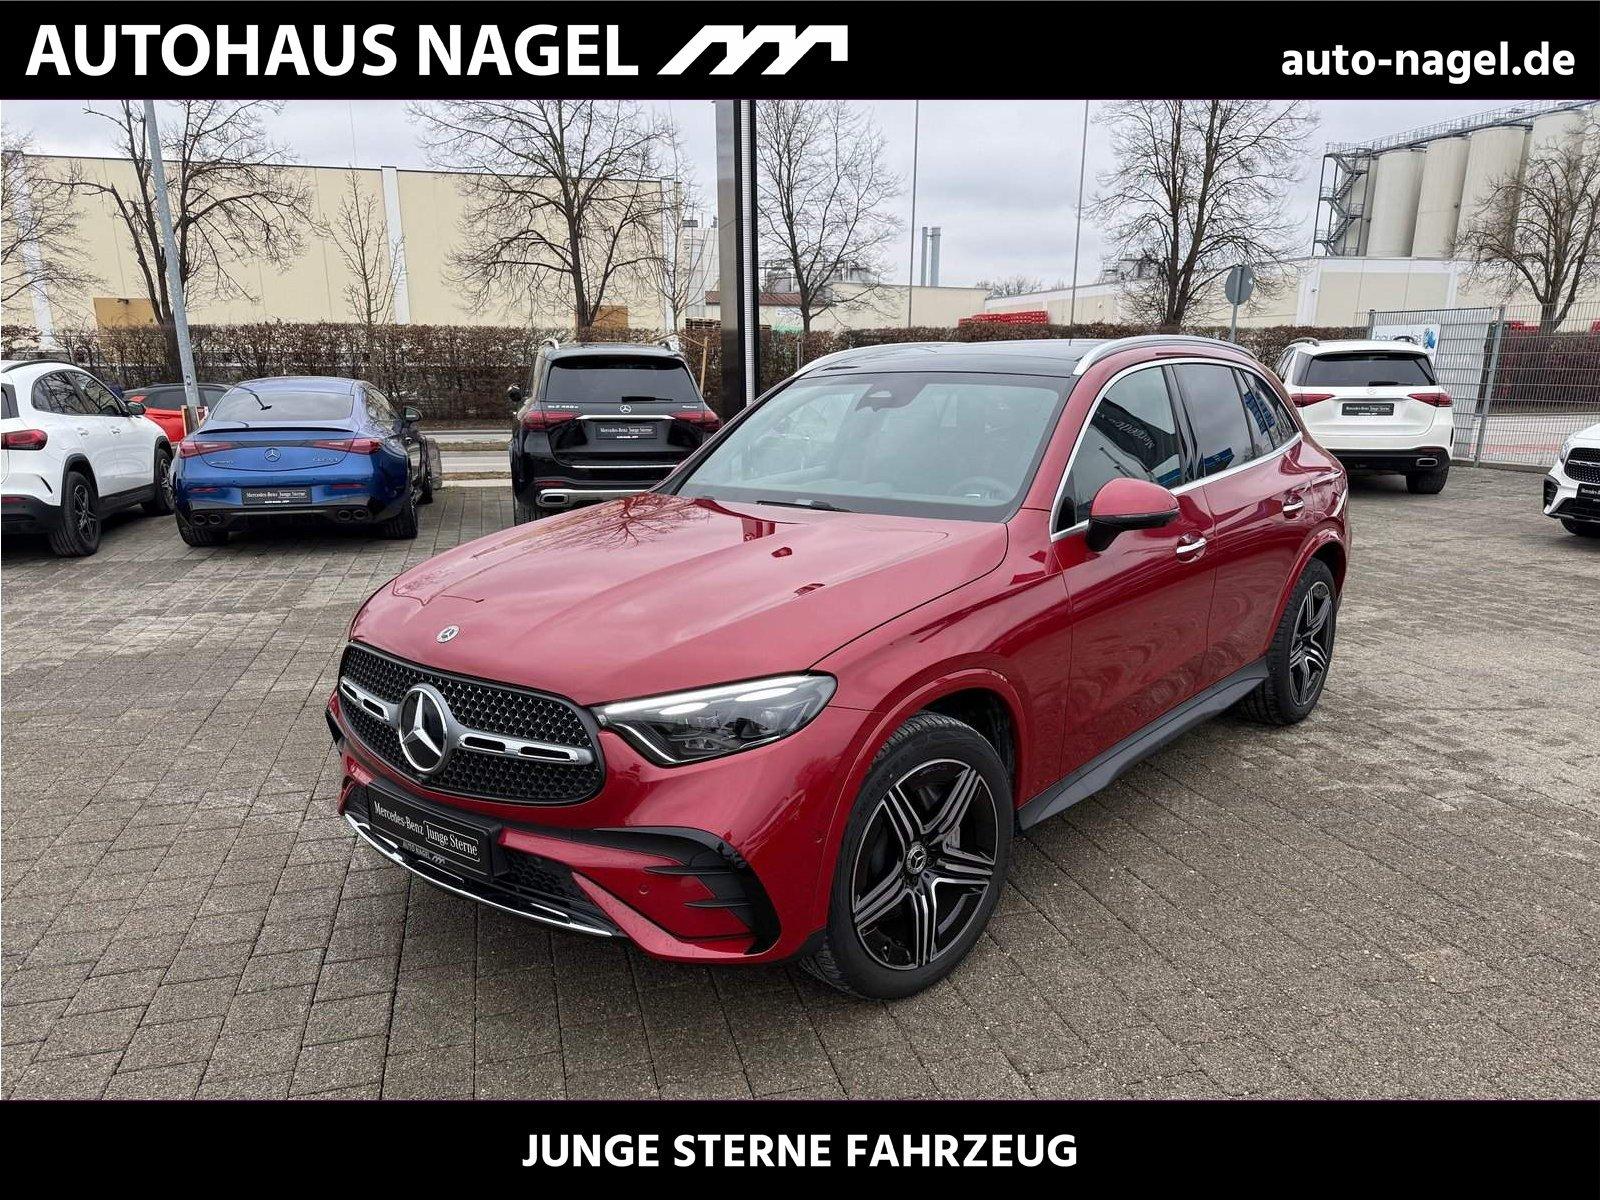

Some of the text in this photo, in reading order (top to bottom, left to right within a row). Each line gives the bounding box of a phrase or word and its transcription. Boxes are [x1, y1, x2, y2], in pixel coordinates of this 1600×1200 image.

[374, 800, 478, 856] Mercedes-Benz Junge Sterne
